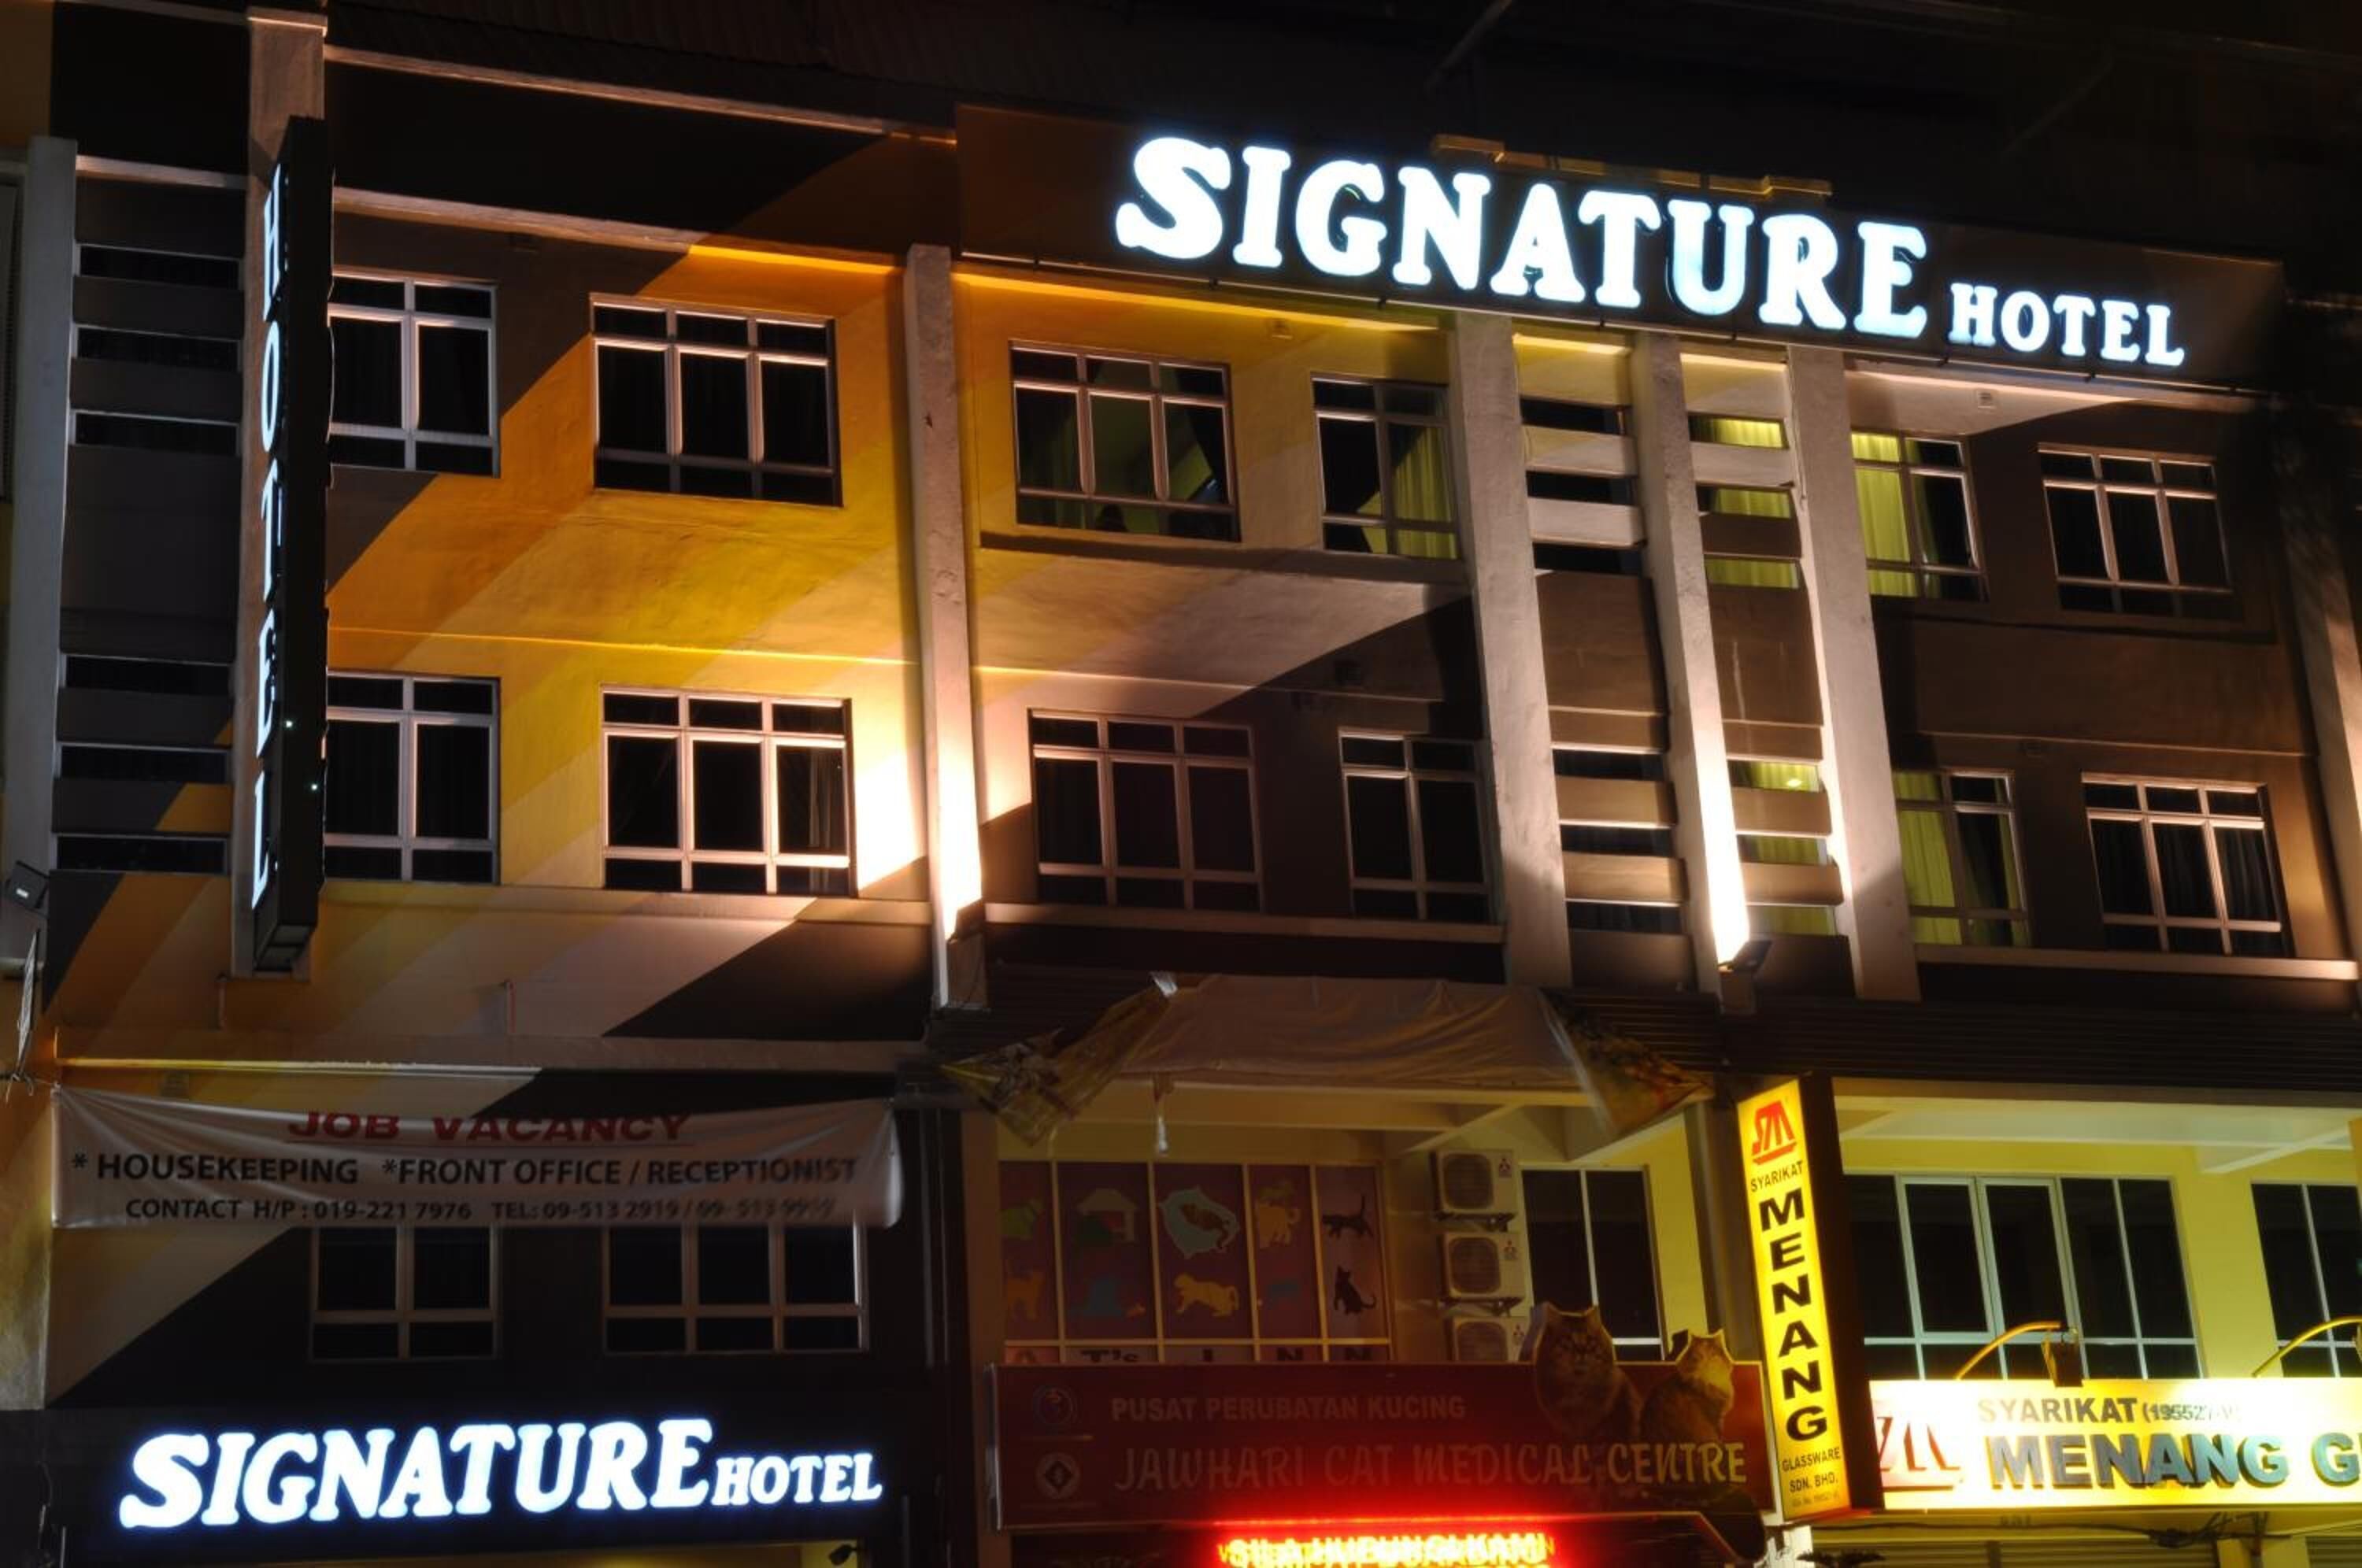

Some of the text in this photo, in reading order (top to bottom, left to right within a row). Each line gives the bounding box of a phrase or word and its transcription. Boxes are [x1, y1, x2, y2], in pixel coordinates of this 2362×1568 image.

[1115, 135, 2186, 367] SIGNATURE HOTEL
[251, 162, 281, 910] HOTEL
[289, 1111, 694, 1141] JOB VACANCY
[98, 1153, 359, 1183] HOUSEKEEPING
[514, 1159, 621, 1184] OFFICE
[647, 1158, 857, 1184] RECEPTIONIST
[1750, 1161, 1804, 1193] SYARIKAT
[126, 1199, 241, 1219] CONTACT
[313, 1200, 407, 1220] 019-221
[415, 1201, 472, 1220] 7976
[1759, 1187, 1828, 1442] MENANG
[1110, 1395, 1468, 1422] PUSAT PERUBATAN KUCING
[1978, 1396, 2138, 1425] SYARIKAT
[120, 1418, 883, 1529] SIGNATURE HOTEL
[1114, 1440, 1749, 1494] JAWHARI CAT MEDICAL CENTRE
[1782, 1447, 1841, 1472] GLASSWARE
[1983, 1433, 2290, 1491] MENANG
[2311, 1431, 2362, 1488] G
